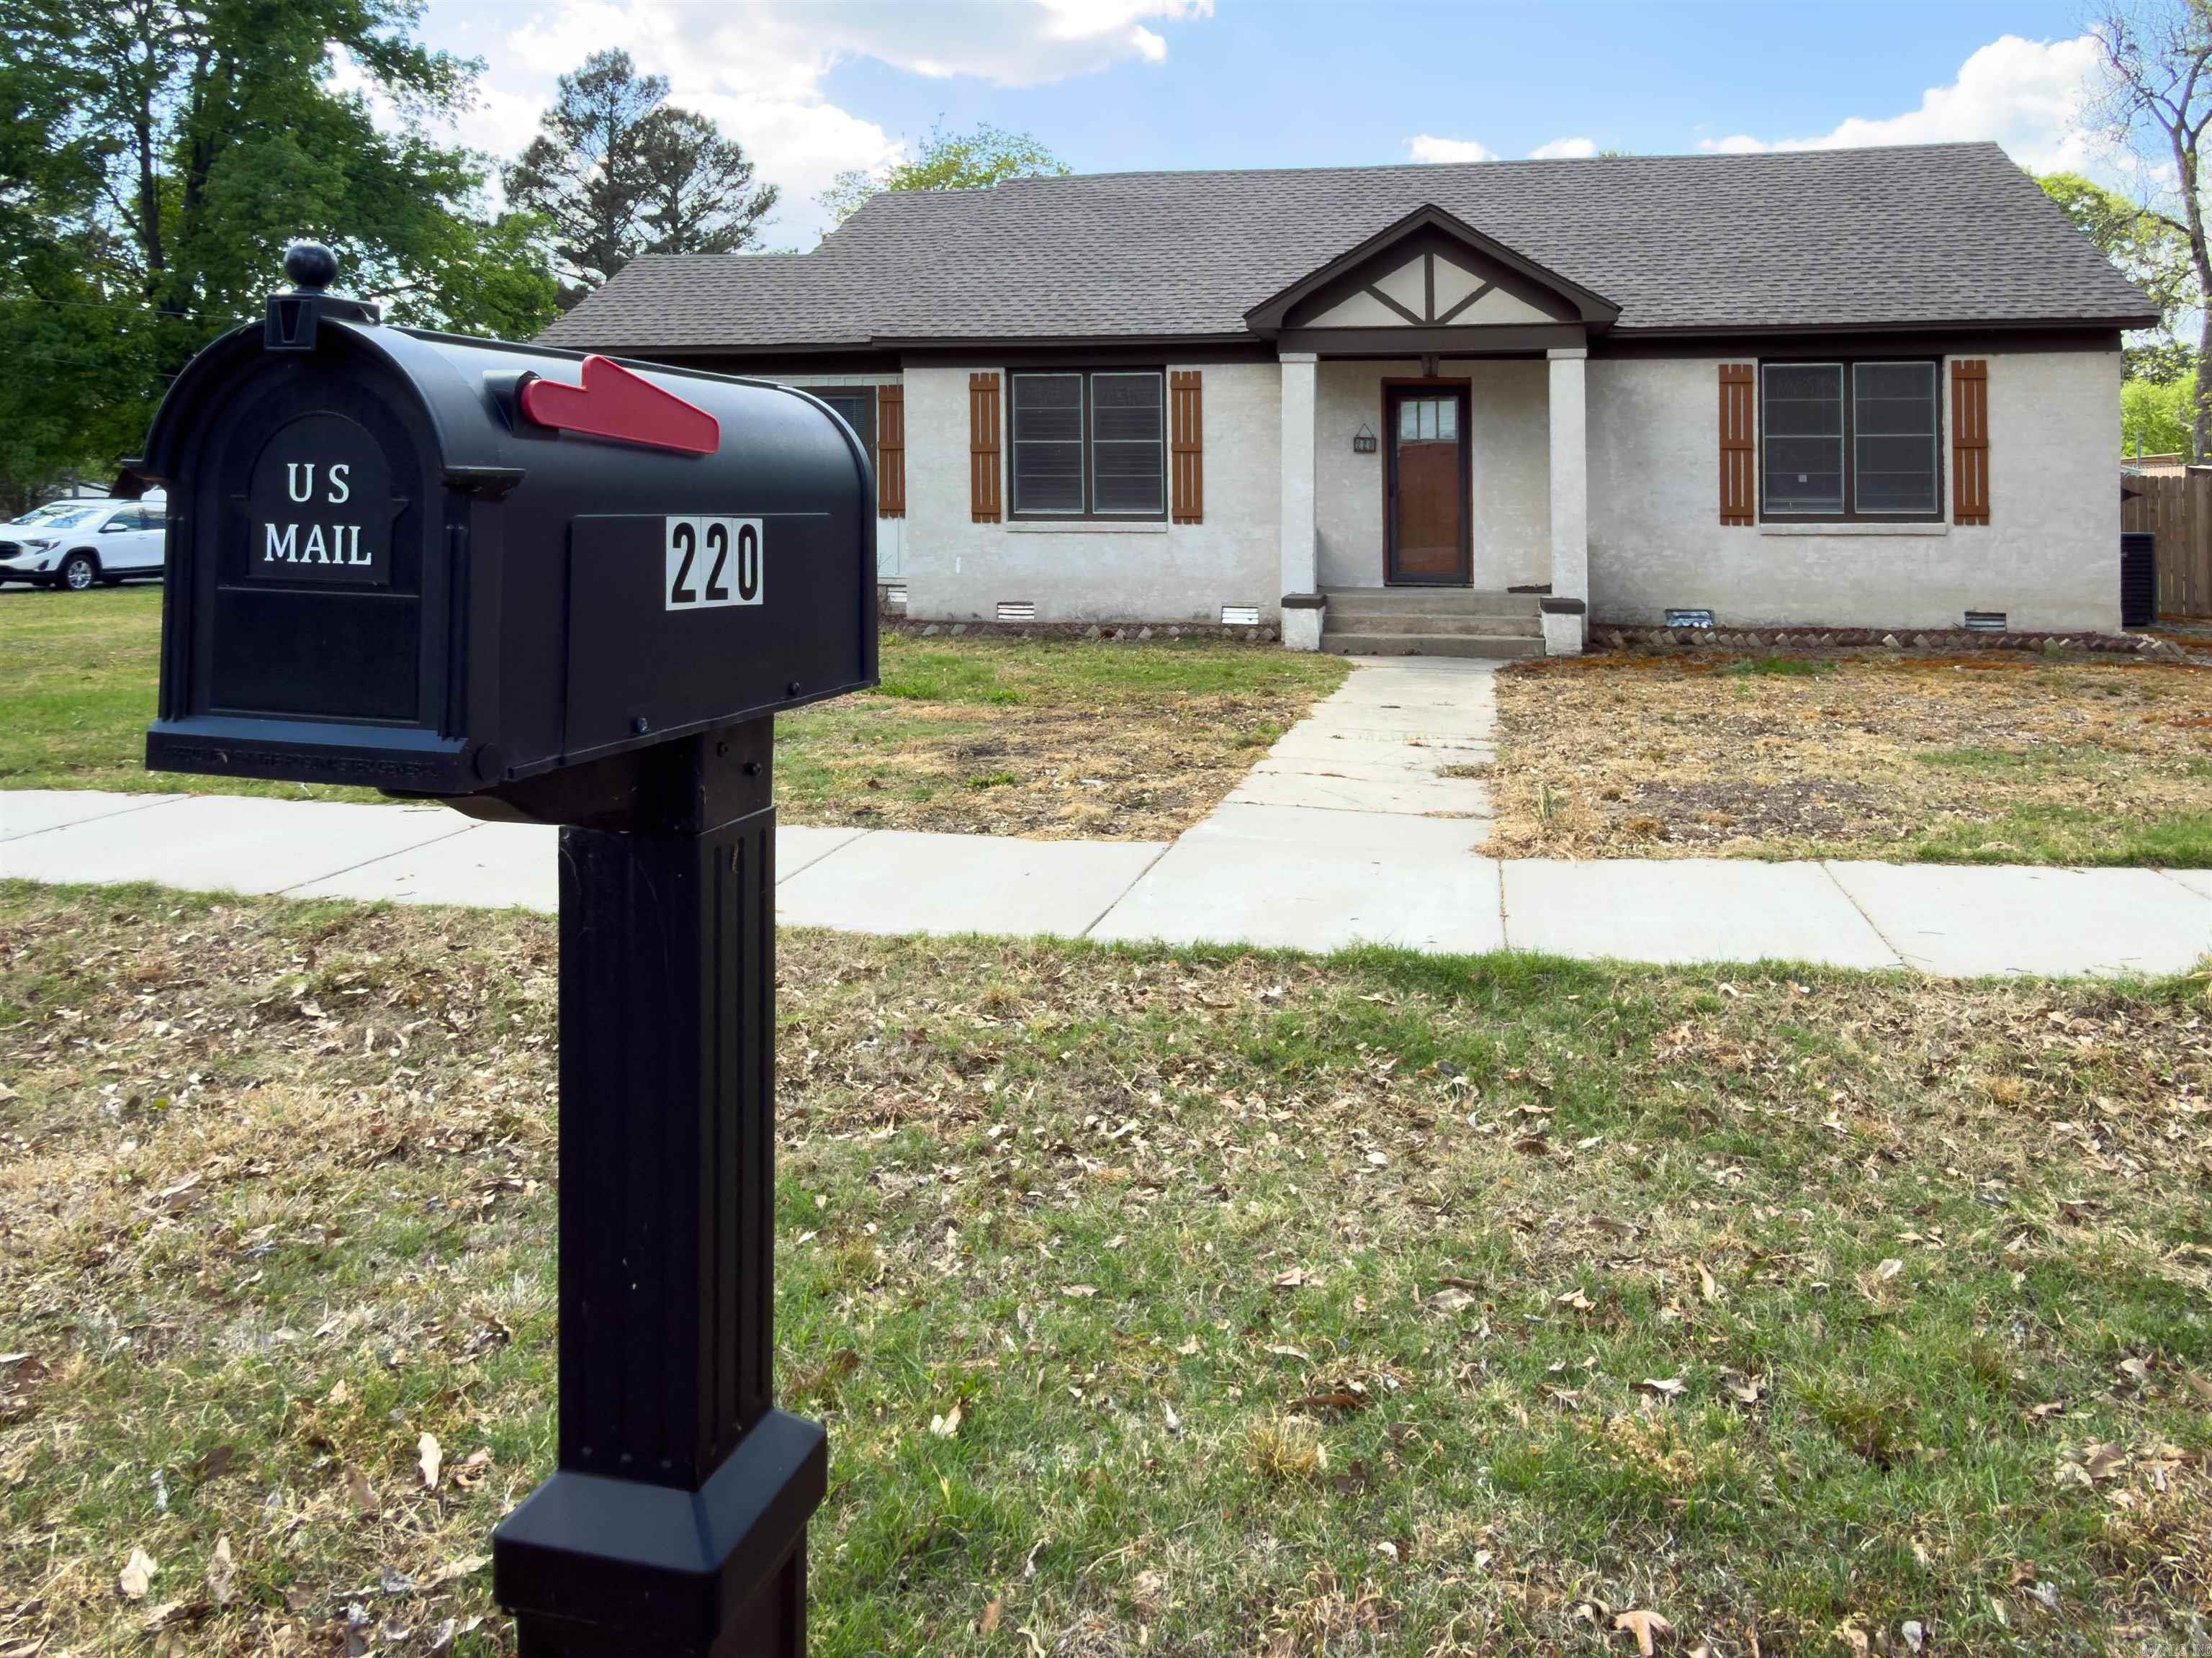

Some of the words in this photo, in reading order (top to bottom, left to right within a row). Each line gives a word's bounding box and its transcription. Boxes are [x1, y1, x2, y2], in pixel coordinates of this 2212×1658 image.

[287, 463, 315, 503] U
[328, 464, 350, 503] S
[264, 523, 372, 565] MAIL
[671, 522, 758, 603] 220
